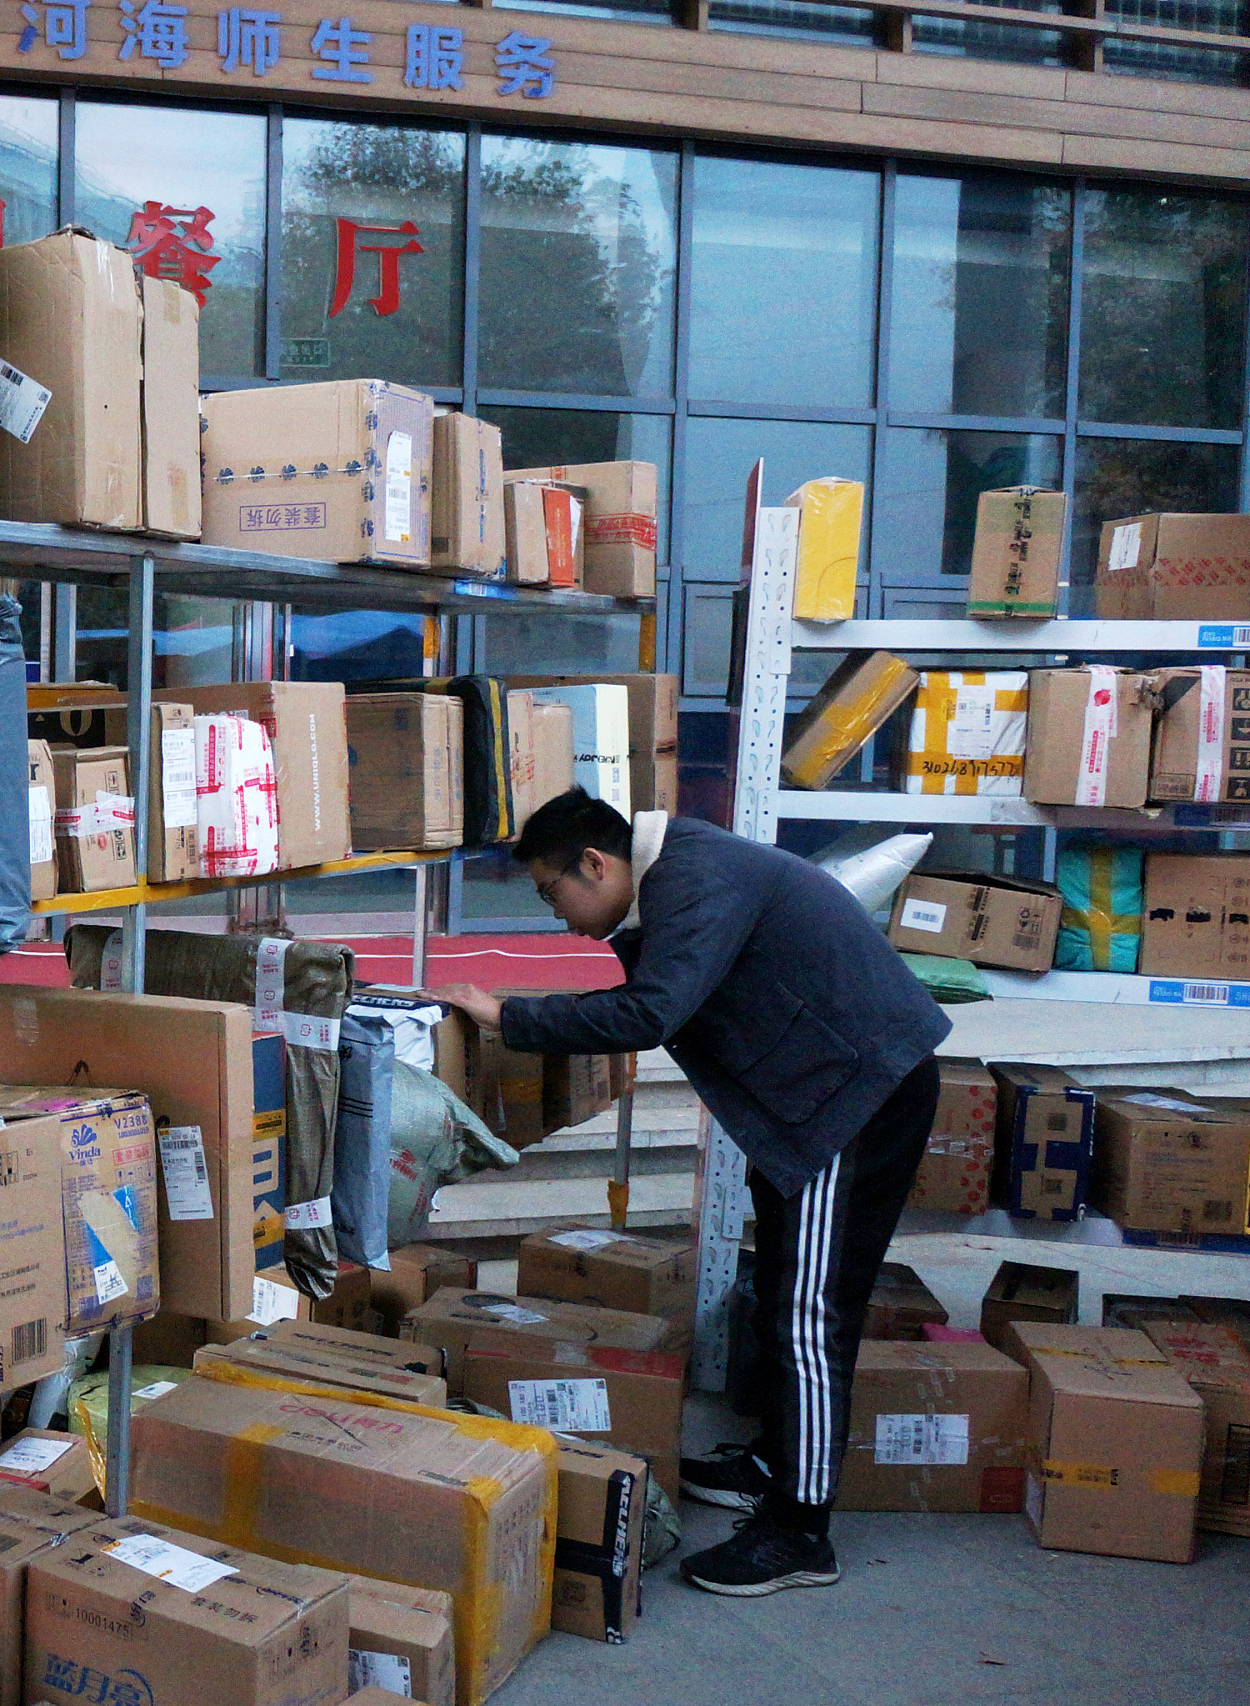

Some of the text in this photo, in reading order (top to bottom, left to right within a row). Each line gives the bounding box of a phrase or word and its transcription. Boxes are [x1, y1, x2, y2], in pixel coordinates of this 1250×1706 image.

[247, 506, 321, 527] 套装勿拆
[308, 713, 321, 832] WWW.UNIQLO.COM
[69, 1147, 101, 1161] Vinda
[75, 1607, 130, 1638] 10001475
